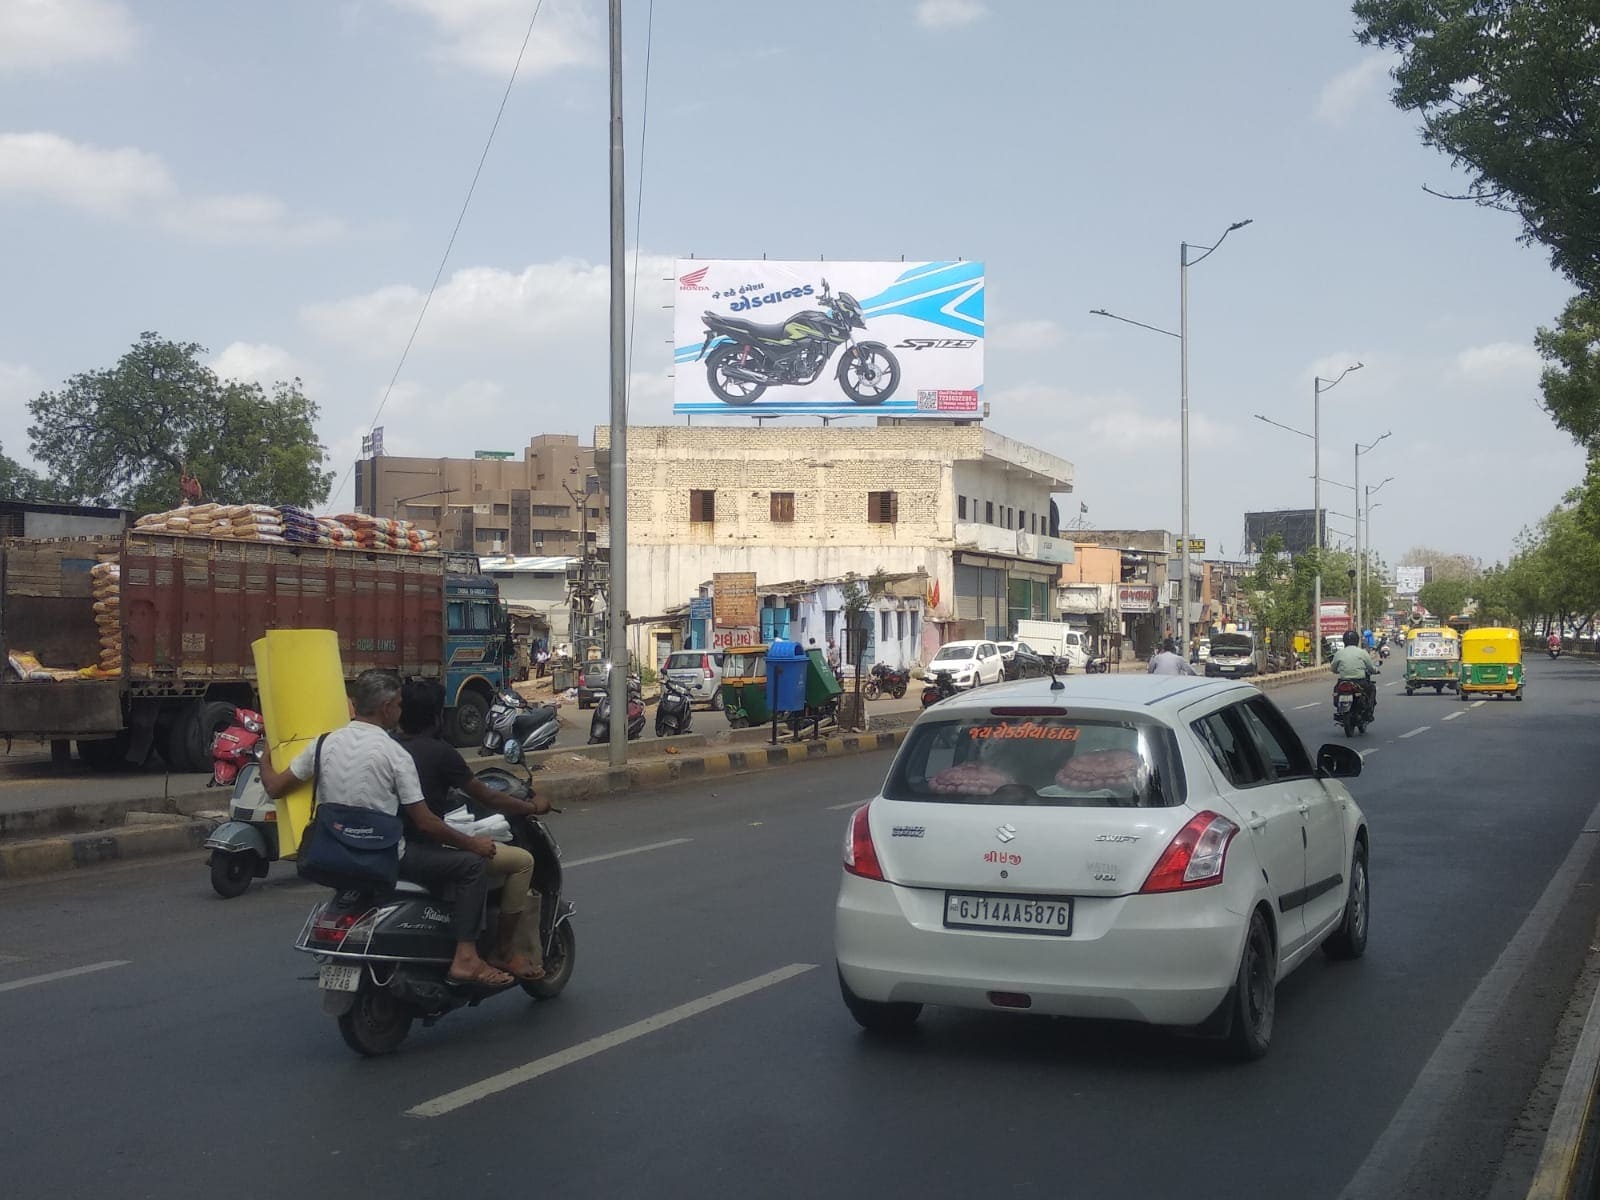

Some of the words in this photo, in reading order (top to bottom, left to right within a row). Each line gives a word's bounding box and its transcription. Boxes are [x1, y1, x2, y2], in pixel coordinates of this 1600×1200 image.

[969, 726, 993, 740] જય
[1095, 834, 1141, 843] SWIFT
[960, 900, 1066, 925] GJ14AA5876
